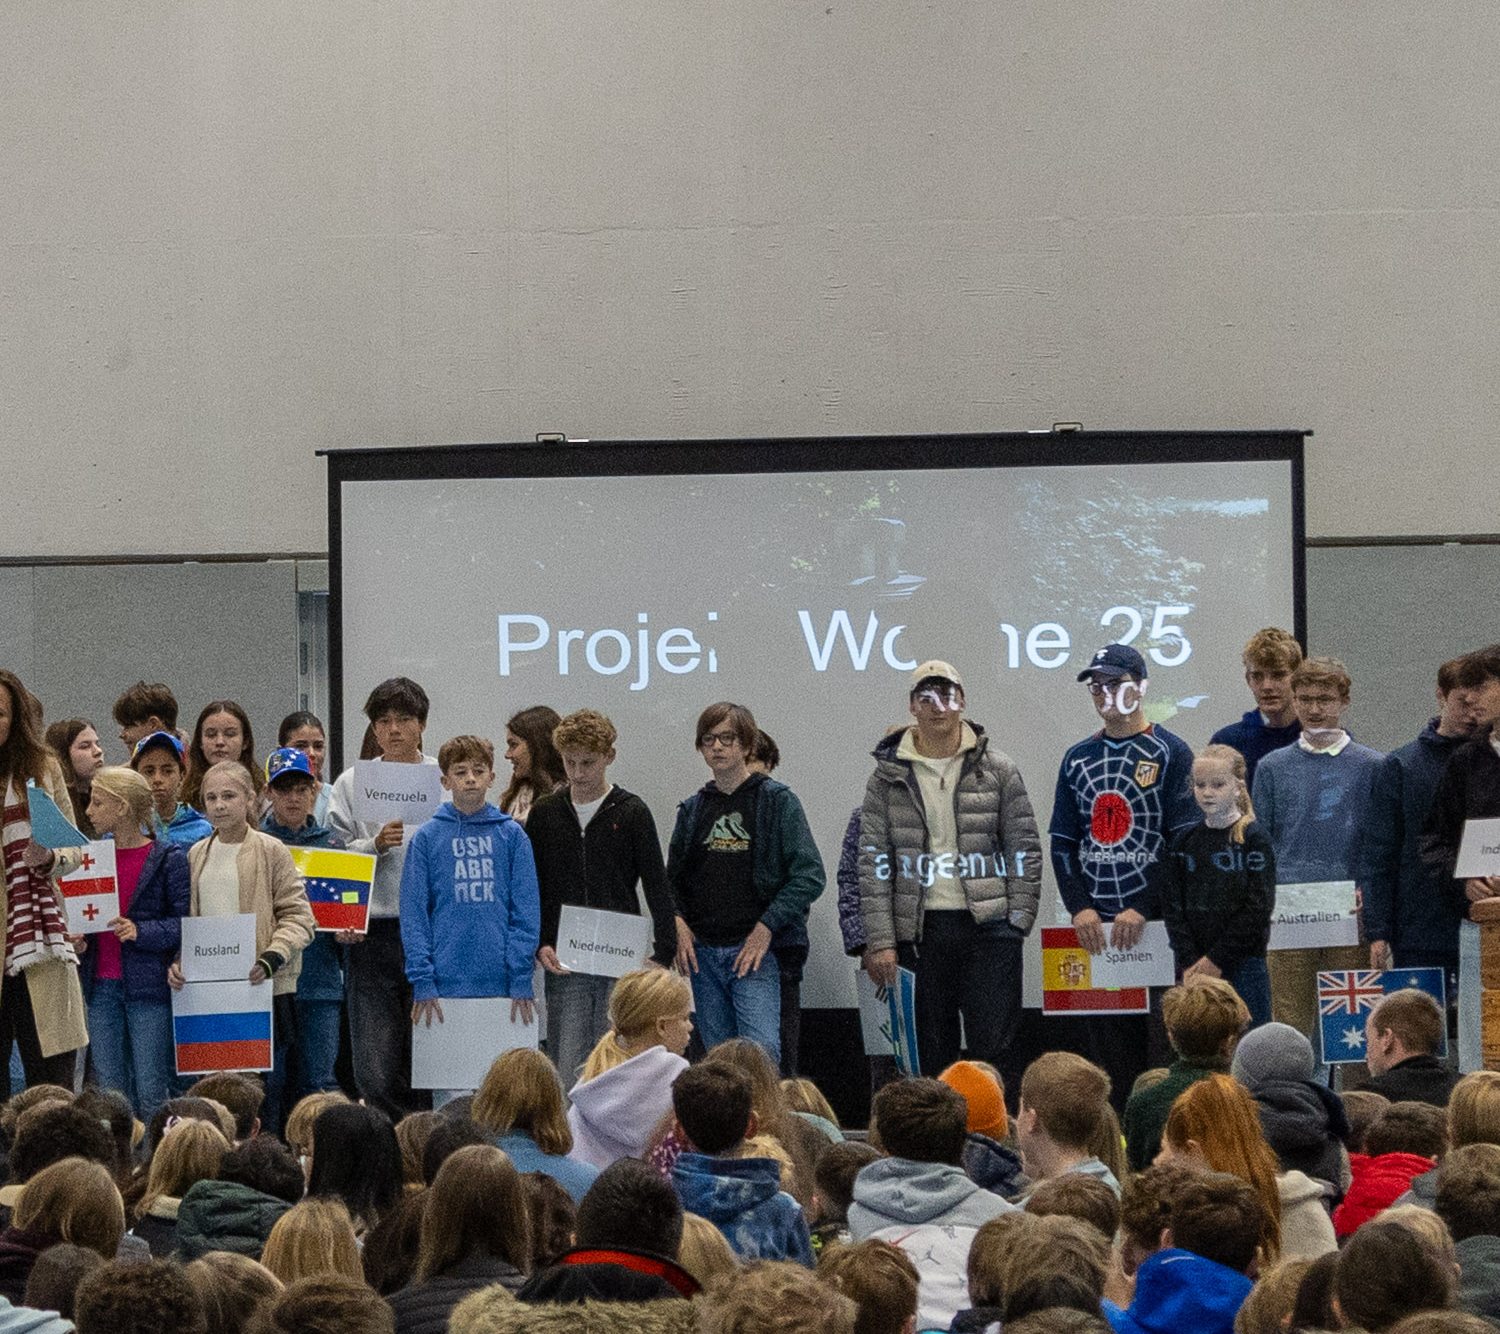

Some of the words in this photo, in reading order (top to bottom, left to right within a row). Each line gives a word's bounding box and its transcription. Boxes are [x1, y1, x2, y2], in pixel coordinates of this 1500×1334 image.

[364, 787, 428, 803] Venezuela
[454, 858, 495, 880] ABR
[1277, 910, 1341, 926] Australien
[194, 942, 241, 957] Russland
[569, 939, 636, 958] Niederlande
[1106, 950, 1153, 965] Spanien
